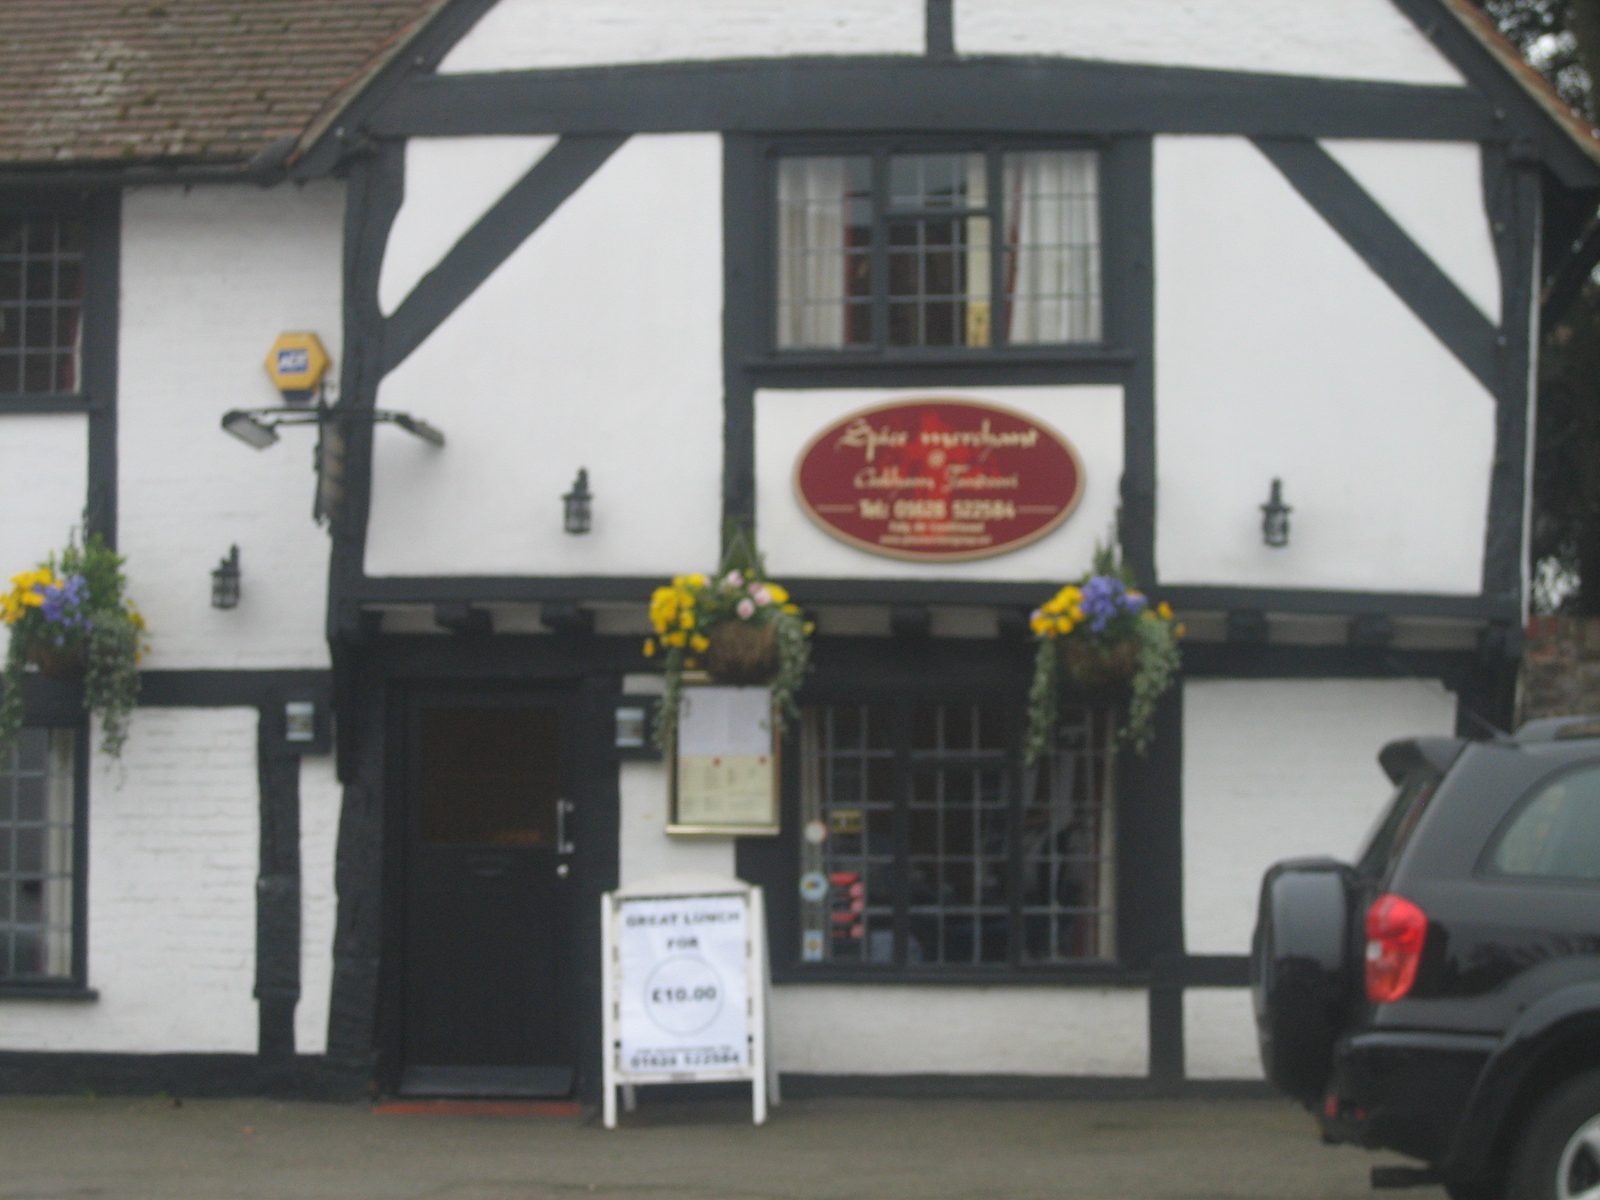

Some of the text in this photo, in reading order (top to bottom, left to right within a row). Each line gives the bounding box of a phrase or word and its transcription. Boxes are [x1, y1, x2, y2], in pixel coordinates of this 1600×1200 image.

[626, 912, 740, 927] GREAT LUNCH
[667, 937, 699, 949] FOR
[652, 986, 717, 1003] £10.00
